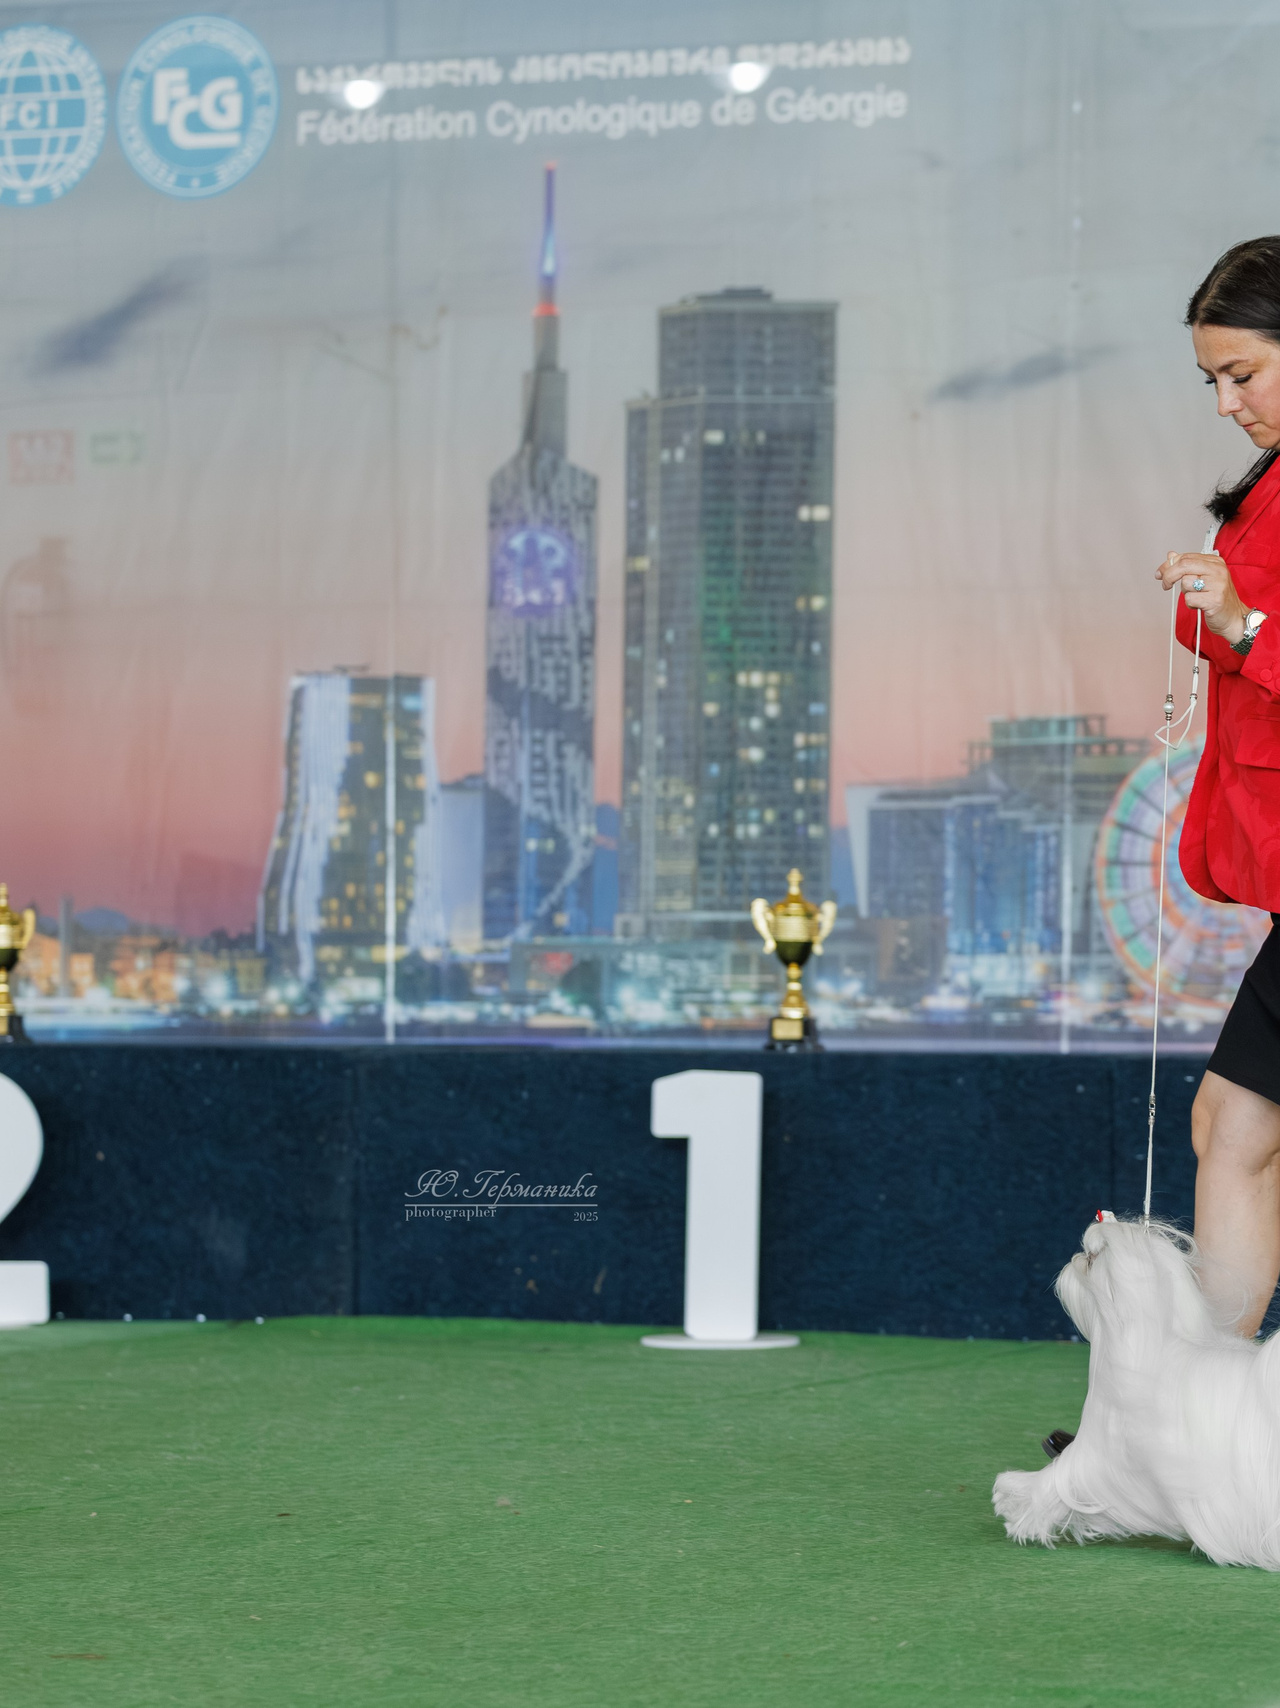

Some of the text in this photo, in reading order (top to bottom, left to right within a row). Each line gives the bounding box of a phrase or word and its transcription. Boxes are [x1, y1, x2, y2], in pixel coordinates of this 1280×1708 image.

[297, 84, 909, 146] Fédération Cynologique de Géorgie
[651, 1068, 763, 1342] 1
